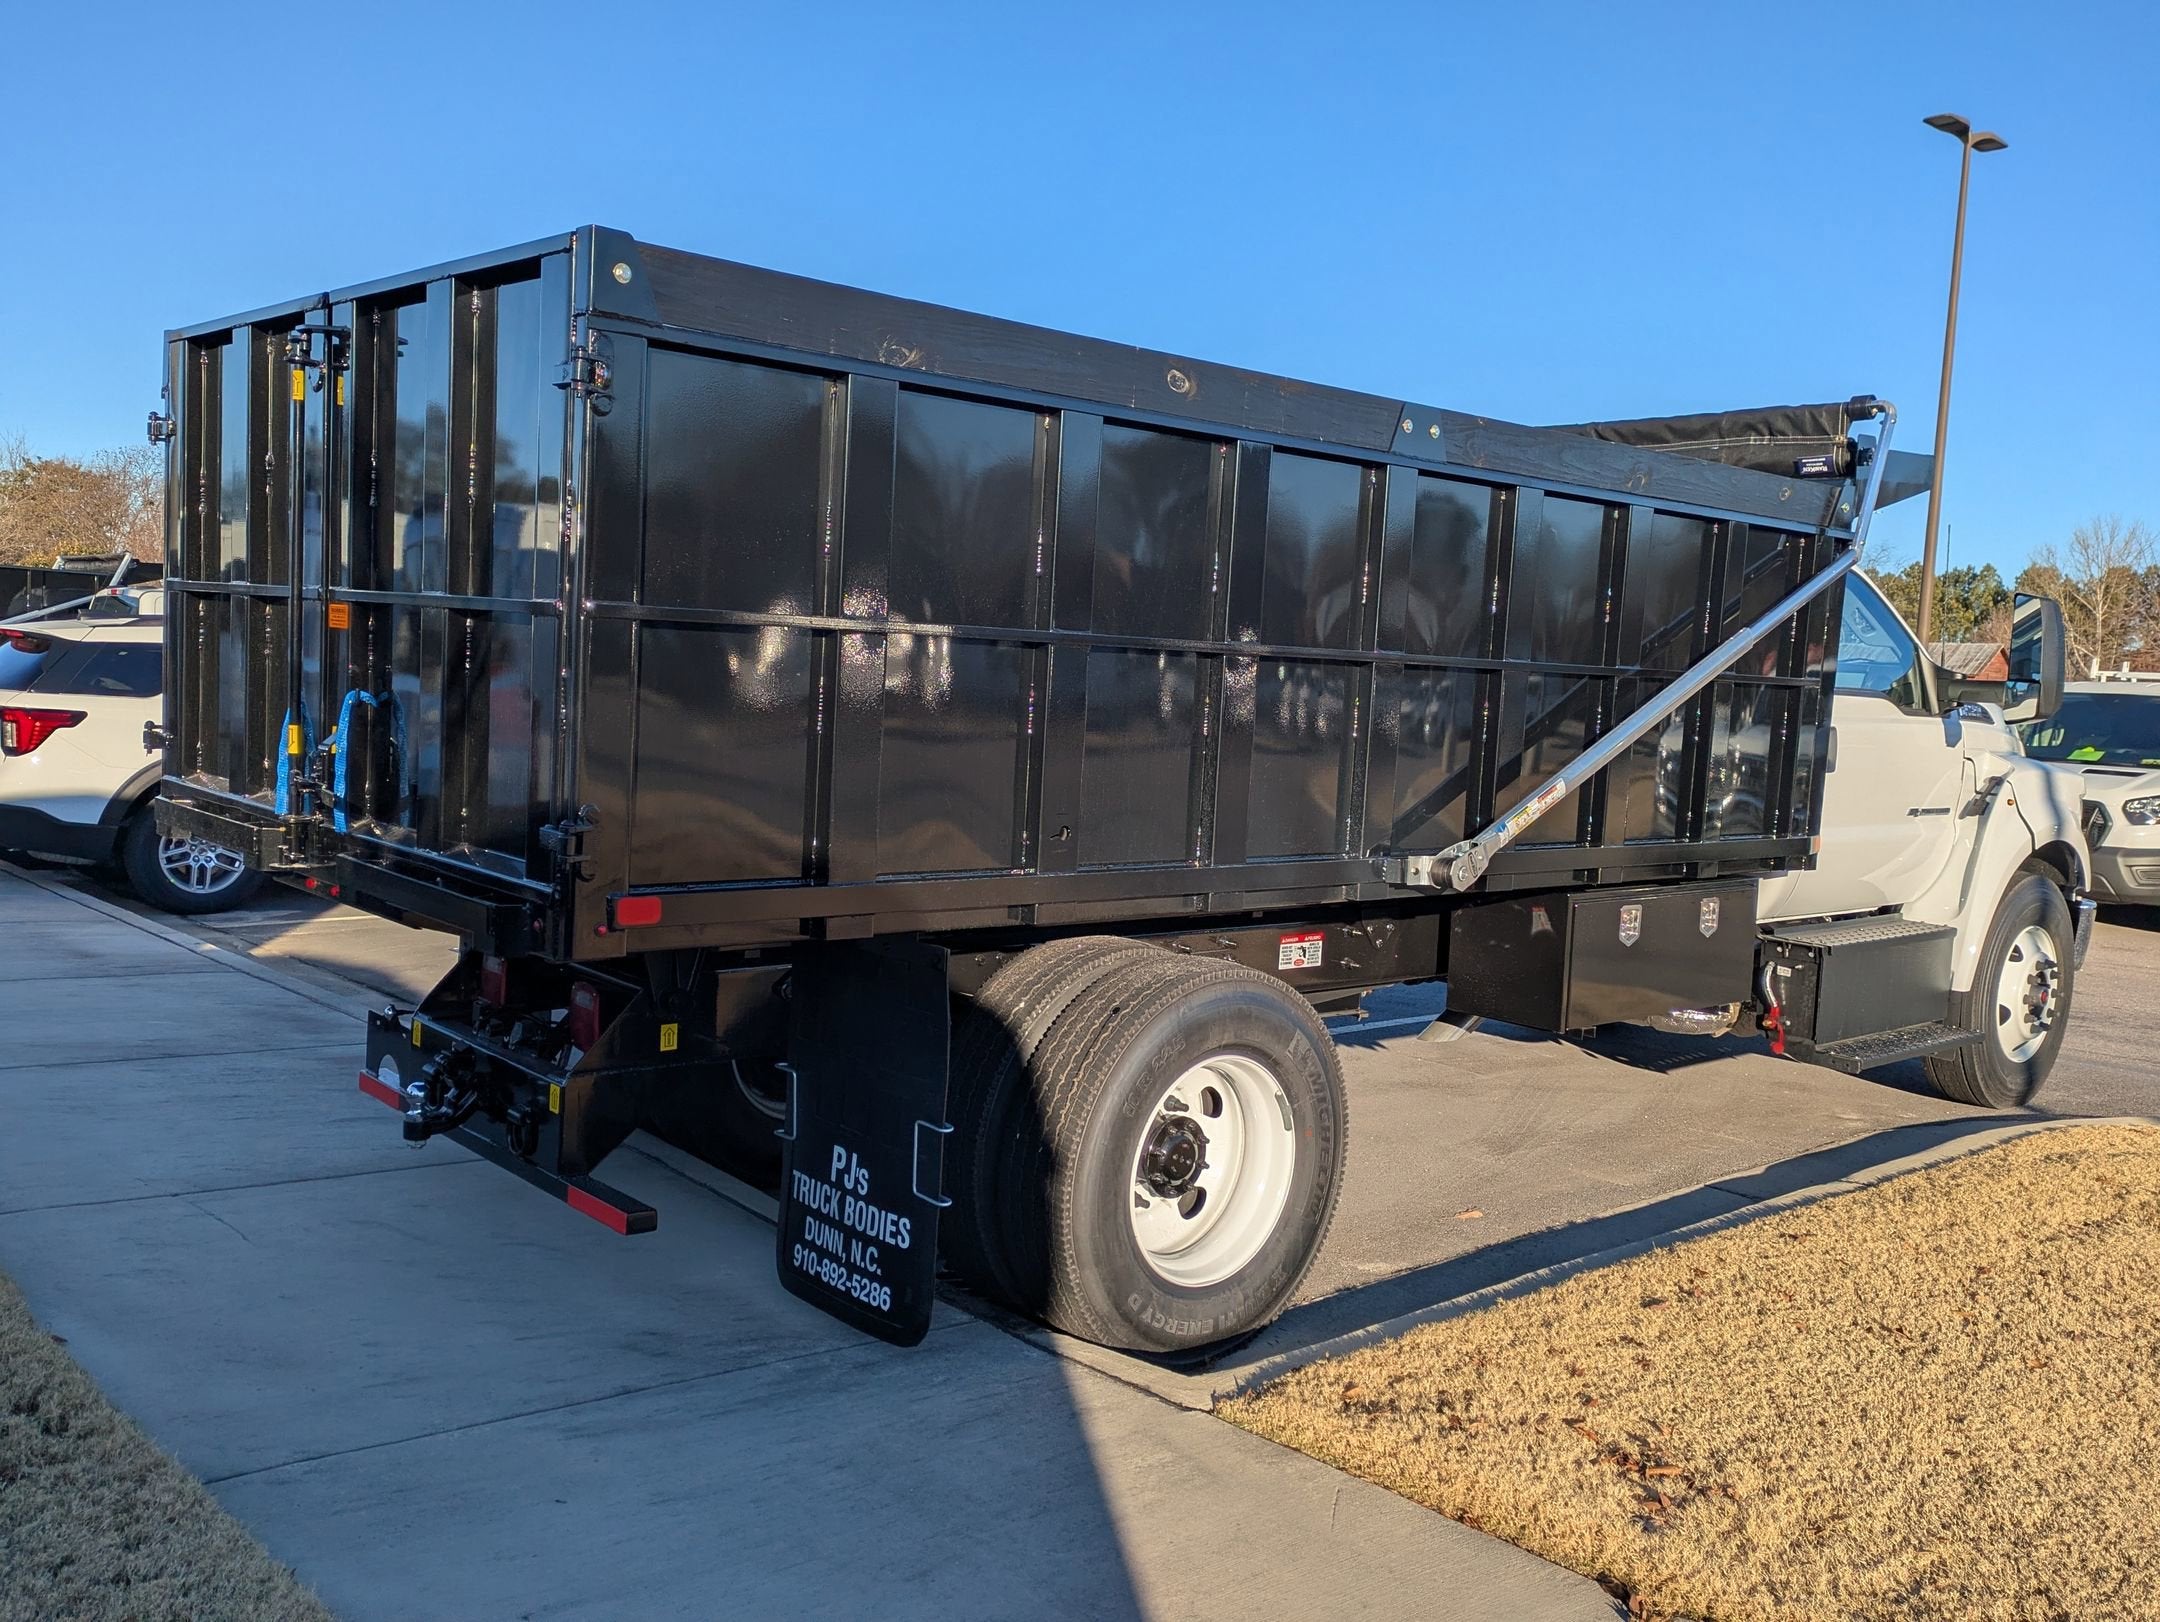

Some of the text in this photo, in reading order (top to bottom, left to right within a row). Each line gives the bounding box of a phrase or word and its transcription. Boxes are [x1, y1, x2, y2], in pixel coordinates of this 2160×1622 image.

[793, 1169, 911, 1249] TRUCK BODIES
[804, 1215, 882, 1276] DUNN, N.C.
[793, 1243, 891, 1312] 910-892-5286
[1127, 1293, 1143, 1312] D
[1138, 1308, 1214, 1336] ENERGY
